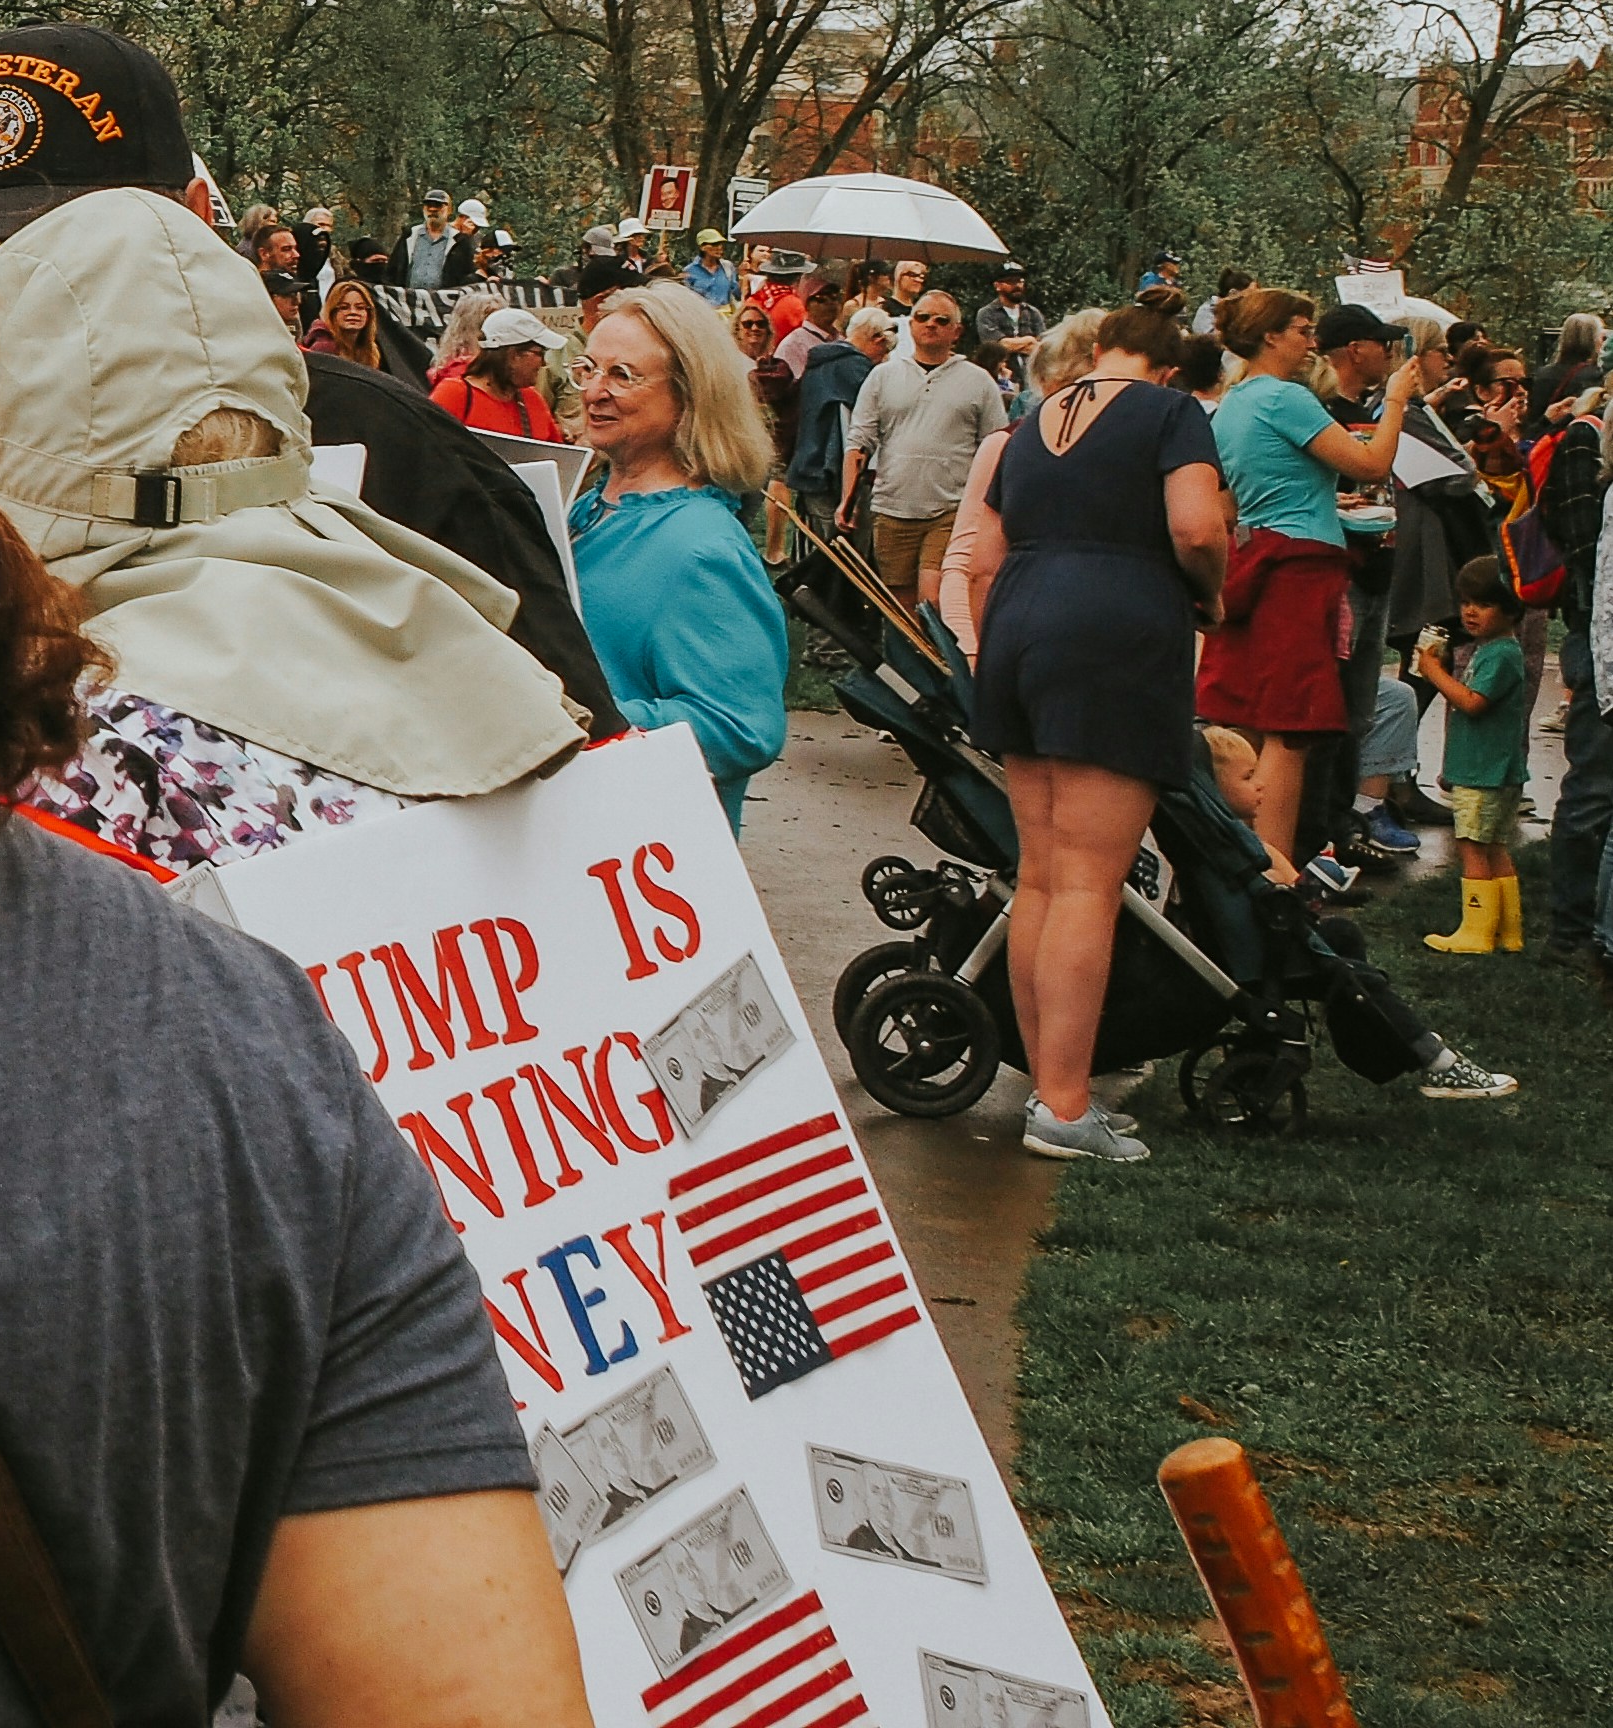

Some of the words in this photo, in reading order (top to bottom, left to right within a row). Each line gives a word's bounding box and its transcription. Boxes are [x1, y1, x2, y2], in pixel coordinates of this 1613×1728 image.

[0, 89, 36, 123] STATES
[304, 917, 540, 1083] UMP
[587, 841, 701, 983] IS
[397, 1031, 676, 1235] NING
[483, 1209, 693, 1412] NEY
